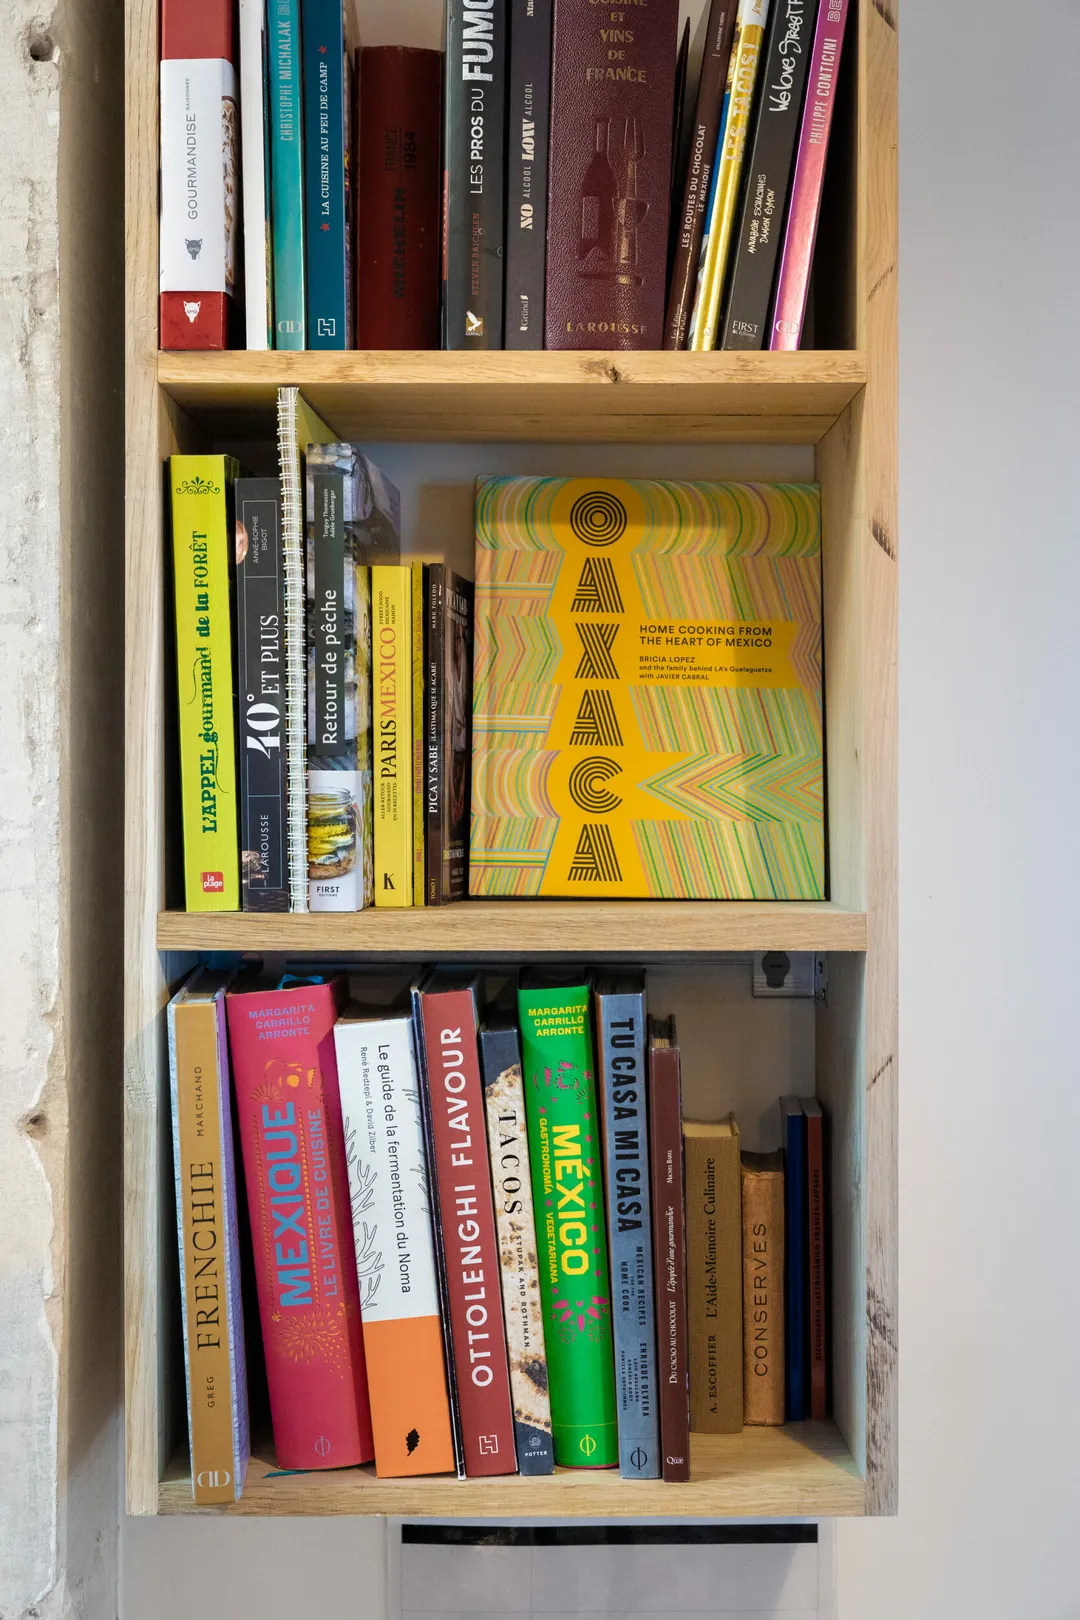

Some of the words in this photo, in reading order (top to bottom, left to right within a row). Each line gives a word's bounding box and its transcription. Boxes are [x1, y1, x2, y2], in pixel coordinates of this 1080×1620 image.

[610, 11, 626, 22] ET
[277, 20, 292, 81] MICHALAK
[599, 29, 634, 43] VINS
[715, 26, 724, 51] VALENTINE
[607, 50, 626, 60] DE
[817, 38, 838, 97] CONTICINI
[319, 61, 328, 93] CAMP
[585, 67, 647, 83] FRANCE
[771, 56, 796, 91] love
[279, 84, 294, 142] CHRISTOPHE
[319, 94, 329, 111] DE
[471, 88, 485, 112] DU
[524, 82, 533, 116] ALCOOL
[769, 92, 791, 112] We
[320, 112, 329, 134] FEU
[470, 115, 484, 160] PROS
[809, 100, 828, 145] PHILIPPE
[320, 134, 329, 152] AU
[385, 127, 398, 172] FRANCE
[403, 131, 418, 170] 1984
[521, 118, 535, 161] LOW
[692, 124, 707, 175] CHOCOLAT
[723, 125, 747, 163] LES
[185, 113, 198, 220] GOURMANDISE
[320, 154, 330, 199] CUISINE
[470, 163, 484, 194] LES
[522, 165, 532, 198] ALCOOL
[700, 163, 711, 200] MEXIQUE
[689, 177, 699, 192] DU
[321, 201, 330, 216] LA
[520, 203, 534, 230] NO
[683, 192, 696, 228] ROUTES
[697, 201, 705, 213] LE
[392, 186, 407, 299] MICHELIN
[472, 212, 480, 258] RAICHLEN
[681, 232, 691, 248] LES
[471, 260, 479, 296] STEVEN
[566, 321, 649, 335] LAROUSSE
[732, 320, 759, 334] FIRST
[188, 530, 209, 588] FORÊT
[195, 591, 209, 612] la
[320, 589, 341, 645] pêche
[195, 615, 210, 638] de
[260, 613, 280, 663] PLUS
[639, 624, 675, 634] HOME
[678, 625, 735, 635] COOKING
[738, 626, 772, 636] FROM
[639, 636, 662, 645] THE
[665, 637, 703, 646] HEART
[706, 638, 722, 646] OF
[725, 638, 772, 648] MEXICO
[320, 652, 337, 675] de
[196, 646, 219, 744] gourmand
[261, 670, 280, 695] ET
[430, 686, 437, 695] SE
[567, 490, 628, 882] OAXACA
[322, 680, 338, 744] Retour
[430, 694, 438, 710] QUE
[428, 743, 439, 774] SABE
[199, 748, 218, 834] L'APPEL
[428, 775, 439, 784] Y
[428, 784, 439, 814] PICA
[259, 813, 269, 873] LAROUSSE
[316, 885, 340, 893] FIRST
[383, 872, 396, 891] K
[249, 1003, 316, 1019] MARGARITA
[255, 1015, 311, 1029] CARRILLO
[527, 1004, 589, 1017] MARGARITA
[533, 1015, 585, 1027] CARRILLO
[257, 1027, 311, 1041] ARRONTE
[535, 1025, 585, 1037] ARRONTE
[610, 1017, 635, 1049] TU
[360, 1046, 369, 1067] René
[378, 1043, 391, 1061] Le
[361, 1068, 371, 1099] Redzepi
[377, 1063, 395, 1102] guide
[440, 1026, 474, 1168] FLAVOUR
[610, 1056, 638, 1121] CASA
[193, 1065, 203, 1138] MARCHAND
[384, 1103, 396, 1122] de
[365, 1108, 375, 1130] David
[384, 1123, 397, 1137] la
[307, 1107, 328, 1182] CUISINE
[367, 1131, 377, 1154] Zilber
[539, 1117, 552, 1196] GASTRONOMÍA
[614, 1130, 640, 1161] MI
[498, 1109, 523, 1215] TACOS
[315, 1186, 330, 1210] DE
[388, 1139, 406, 1228] fermentation
[551, 1123, 592, 1276] MÉXICO
[616, 1166, 643, 1234] CASA
[703, 1157, 716, 1216] Culinaire
[261, 1100, 314, 1308] MEXIQUE
[319, 1214, 337, 1270] LIVRE
[396, 1231, 409, 1250] du
[664, 1205, 677, 1248] gourmandise
[189, 1161, 221, 1352] FRENCHIE
[515, 1234, 525, 1273] STUPAK
[545, 1211, 557, 1284] VEGETARIANA
[398, 1253, 411, 1294] Noma
[620, 1261, 629, 1285] HOME
[635, 1246, 645, 1285] MEXICAN
[704, 1218, 718, 1319] L'Aide-Mémoire
[323, 1274, 338, 1297] LE
[454, 1184, 494, 1388] OTTOLENGHI
[518, 1277, 526, 1298] AND
[621, 1289, 630, 1312] COOK
[753, 1222, 768, 1377] CONSERVES
[637, 1289, 647, 1326] RECIPES
[669, 1300, 677, 1337] CHOCOLAT
[520, 1301, 531, 1349] ROTHMAN
[814, 1308, 822, 1362] DICCIONARIO
[669, 1337, 677, 1347] AU
[640, 1342, 649, 1381] ENRIQUE
[669, 1347, 678, 1371] CACAO
[708, 1334, 718, 1399] ESCOFFIER
[206, 1375, 215, 1409] GREG
[669, 1371, 678, 1384] DU
[641, 1384, 650, 1417] OLVERA
[709, 1402, 718, 1414] A.
